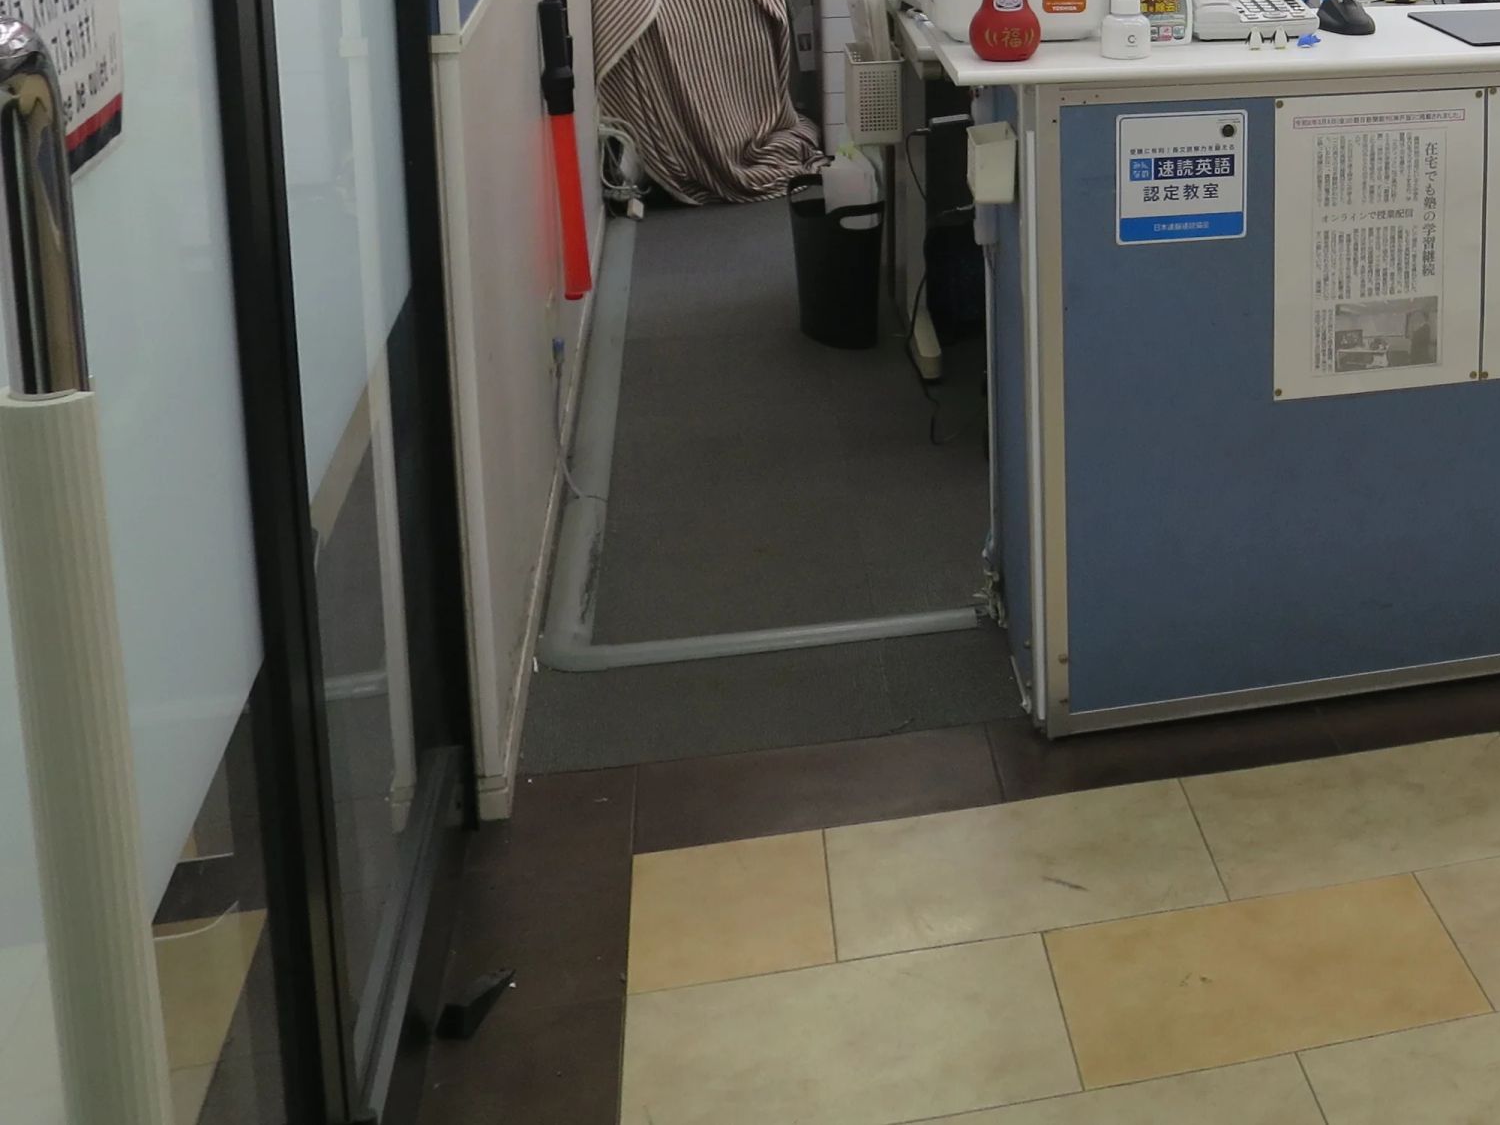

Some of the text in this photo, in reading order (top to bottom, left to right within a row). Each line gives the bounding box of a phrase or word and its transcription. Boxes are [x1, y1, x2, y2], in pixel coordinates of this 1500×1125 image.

[1001, 27, 1022, 48] 福
[1158, 157, 1231, 177] 速読英語
[1143, 183, 1219, 202] 認定教室
[1322, 209, 1414, 223] オンラインで授業配信
[1422, 142, 1438, 277] 在宅でも塾の学習継続
